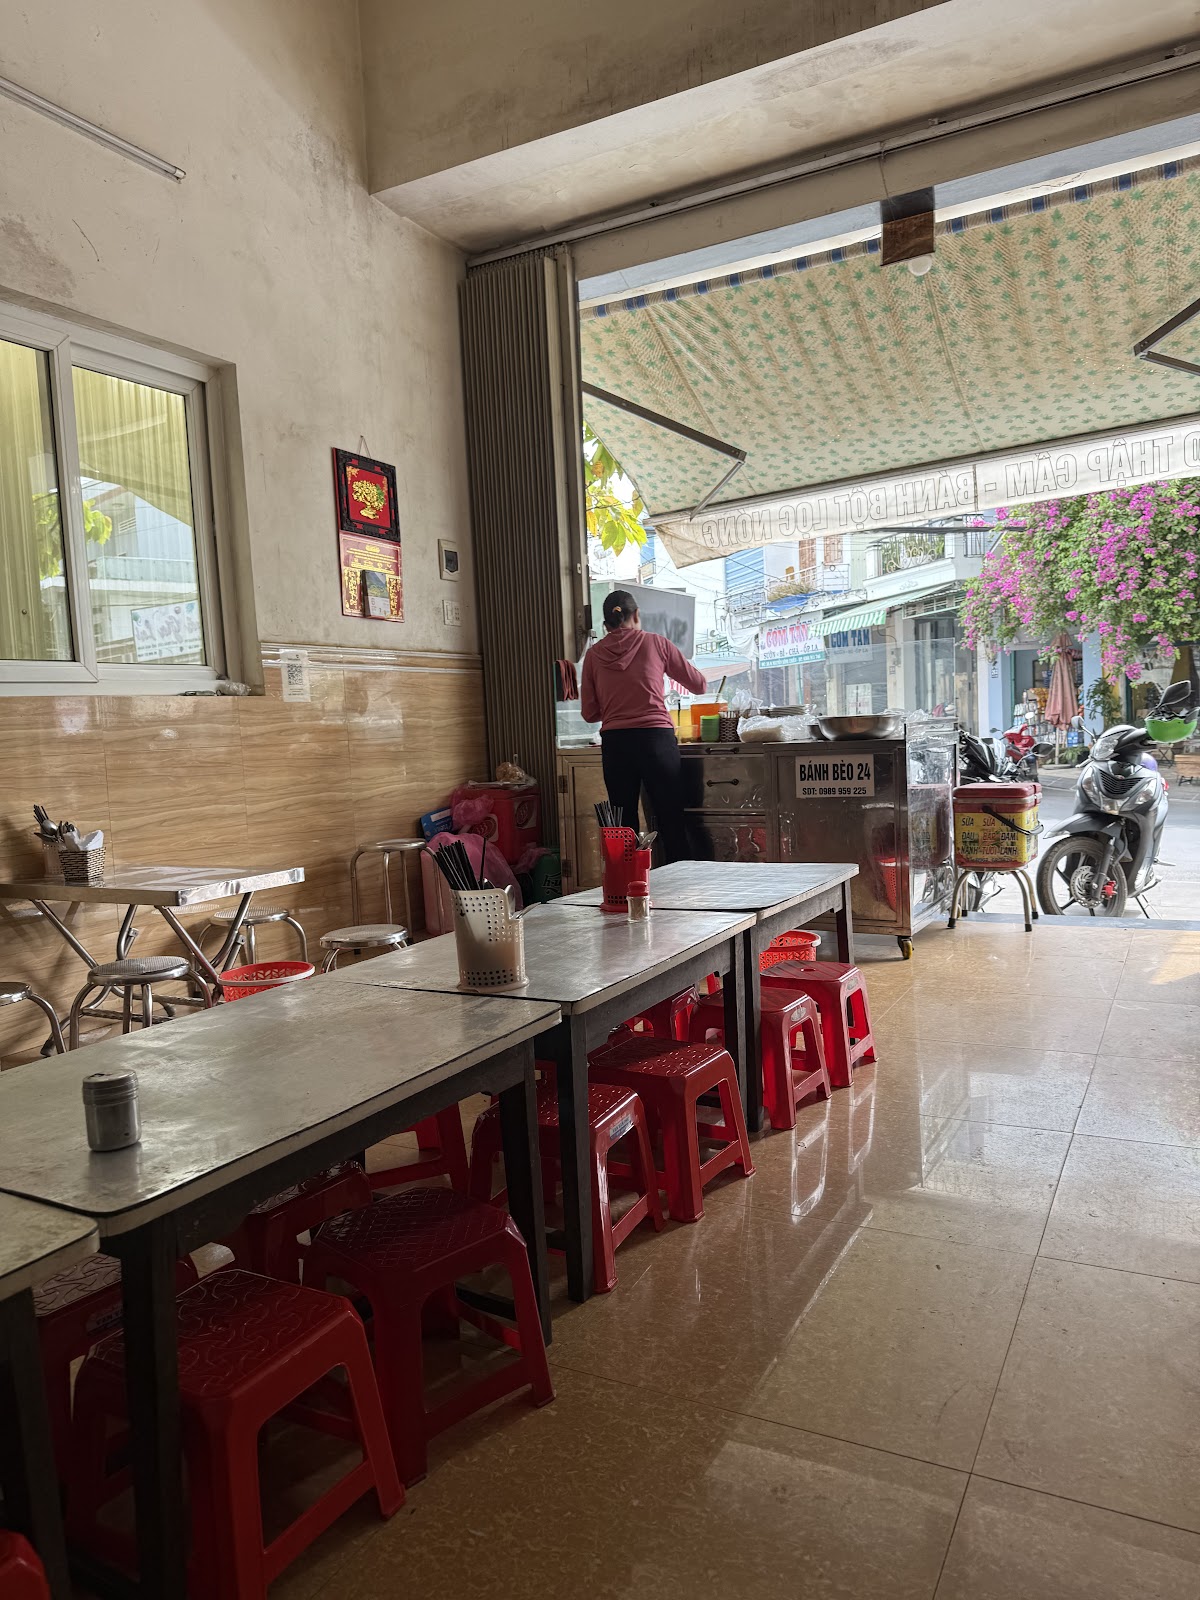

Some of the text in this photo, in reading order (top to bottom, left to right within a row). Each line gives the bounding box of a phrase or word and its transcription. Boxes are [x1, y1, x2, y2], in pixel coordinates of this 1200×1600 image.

[799, 759, 871, 781] BÁNH BÈO 24
[818, 787, 836, 795] 0989
[838, 787, 852, 795] 959
[853, 786, 867, 795] 225
